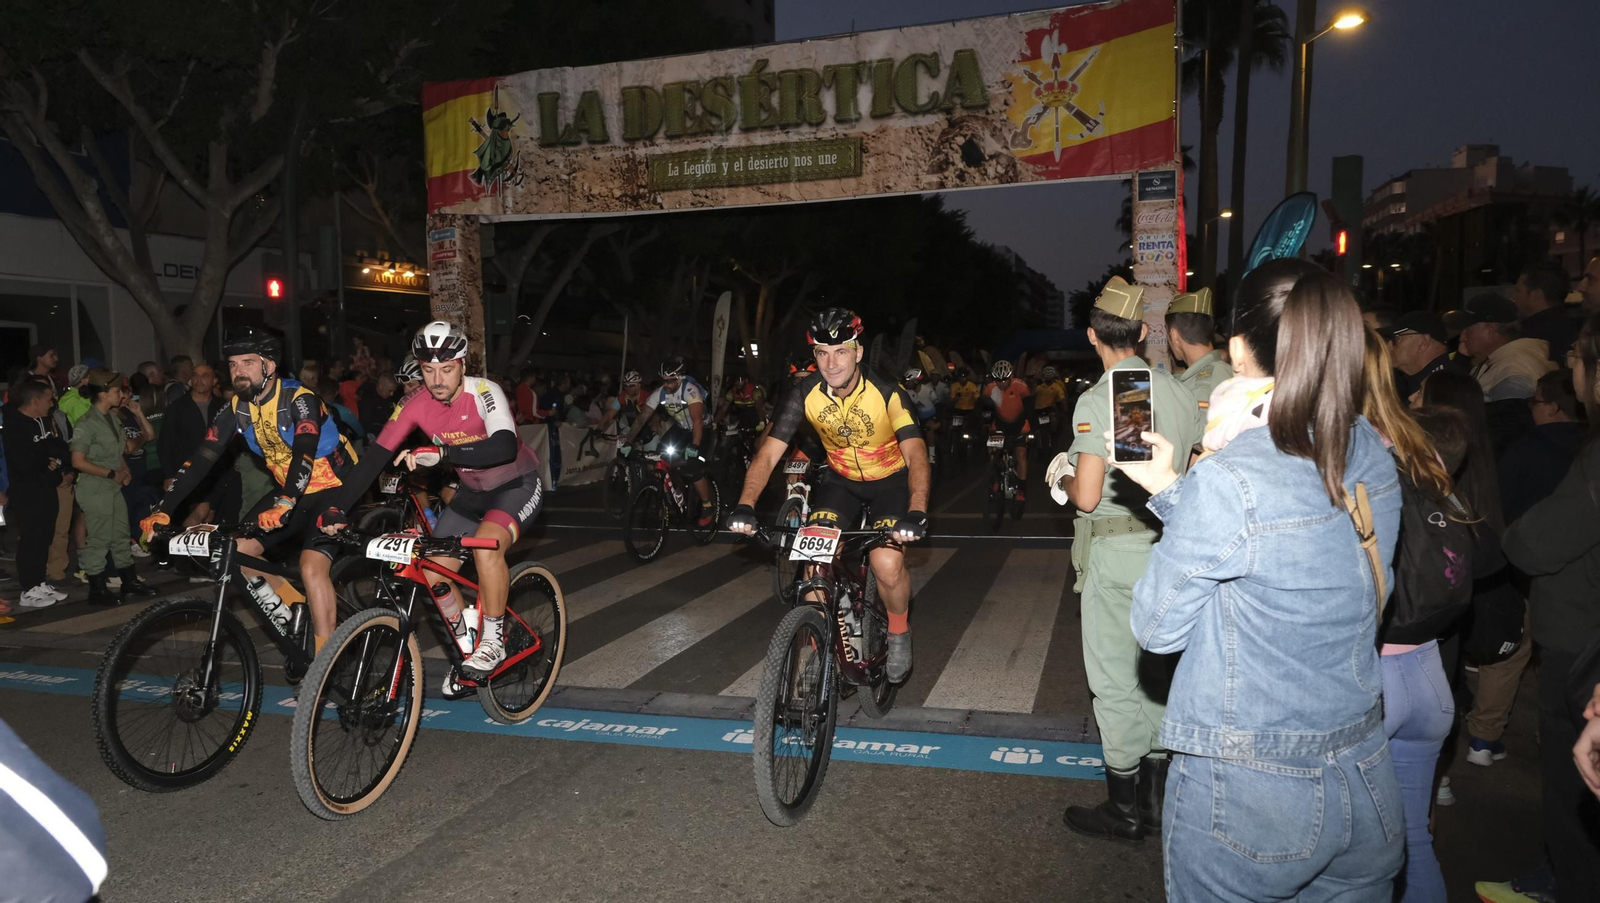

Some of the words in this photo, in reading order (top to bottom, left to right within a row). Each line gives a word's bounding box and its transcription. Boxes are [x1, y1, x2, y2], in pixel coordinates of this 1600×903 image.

[538, 90, 610, 146] LA
[621, 49, 990, 142] DESÉRTICA
[667, 163, 680, 178] La
[683, 161, 717, 179] Legión
[722, 162, 729, 176] y
[734, 157, 744, 172] el
[748, 155, 790, 171] desierto
[794, 156, 813, 168] nos
[818, 154, 839, 166] une
[1138, 241, 1174, 251] RENTA
[441, 431, 468, 440] VISTA
[809, 511, 839, 522] MTB
[376, 537, 410, 553] 7291
[799, 536, 834, 553] 6694
[228, 710, 253, 753] MAXXIS
[536, 718, 679, 736] cajamar
